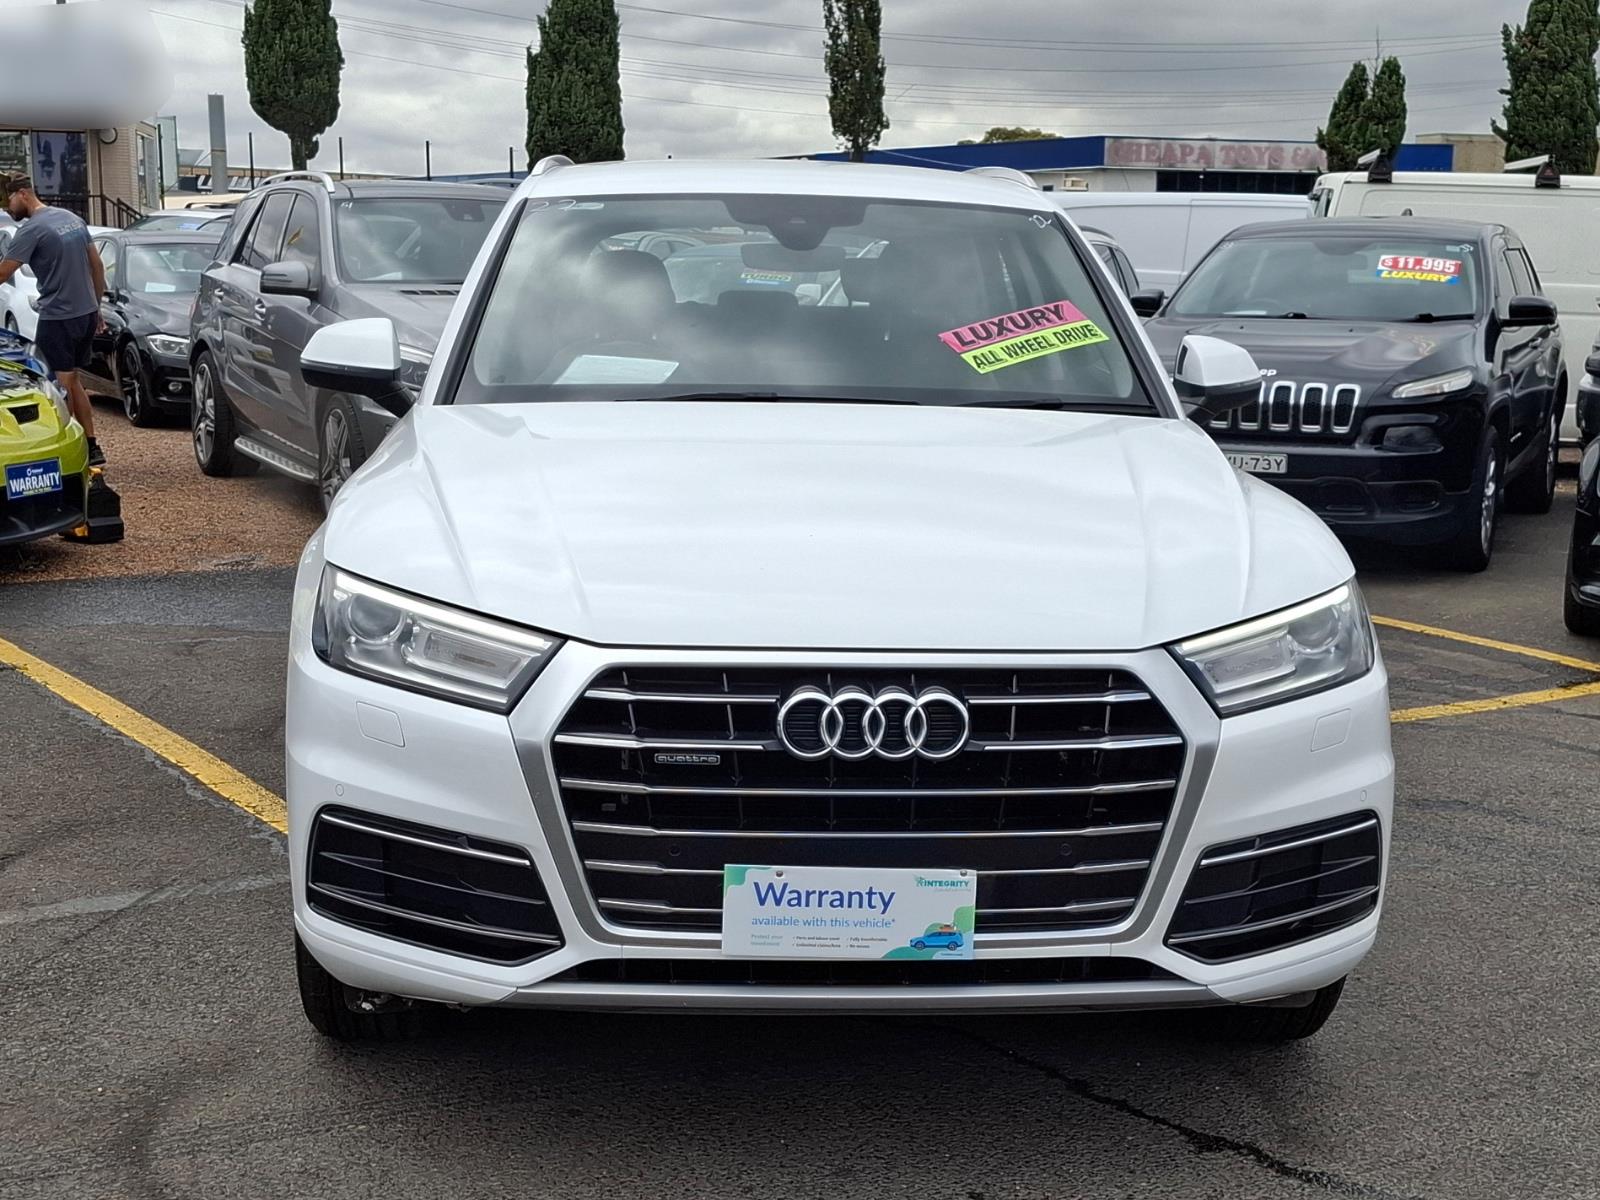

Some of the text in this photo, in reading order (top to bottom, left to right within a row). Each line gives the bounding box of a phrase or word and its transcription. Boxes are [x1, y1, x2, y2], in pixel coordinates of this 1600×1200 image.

[1219, 144, 1284, 166] TOYS
[1383, 257, 1456, 273] $11,995
[1381, 271, 1453, 282] LUXURY
[952, 304, 1066, 347] LUXURY
[972, 324, 1100, 369] ALL WHEEL DRIVE
[10, 472, 60, 493] WARRANTY
[657, 755, 717, 763] quattro
[753, 881, 896, 915] Warranty
[751, 915, 800, 926] available
[802, 916, 827, 927] with
[830, 917, 850, 928] this
